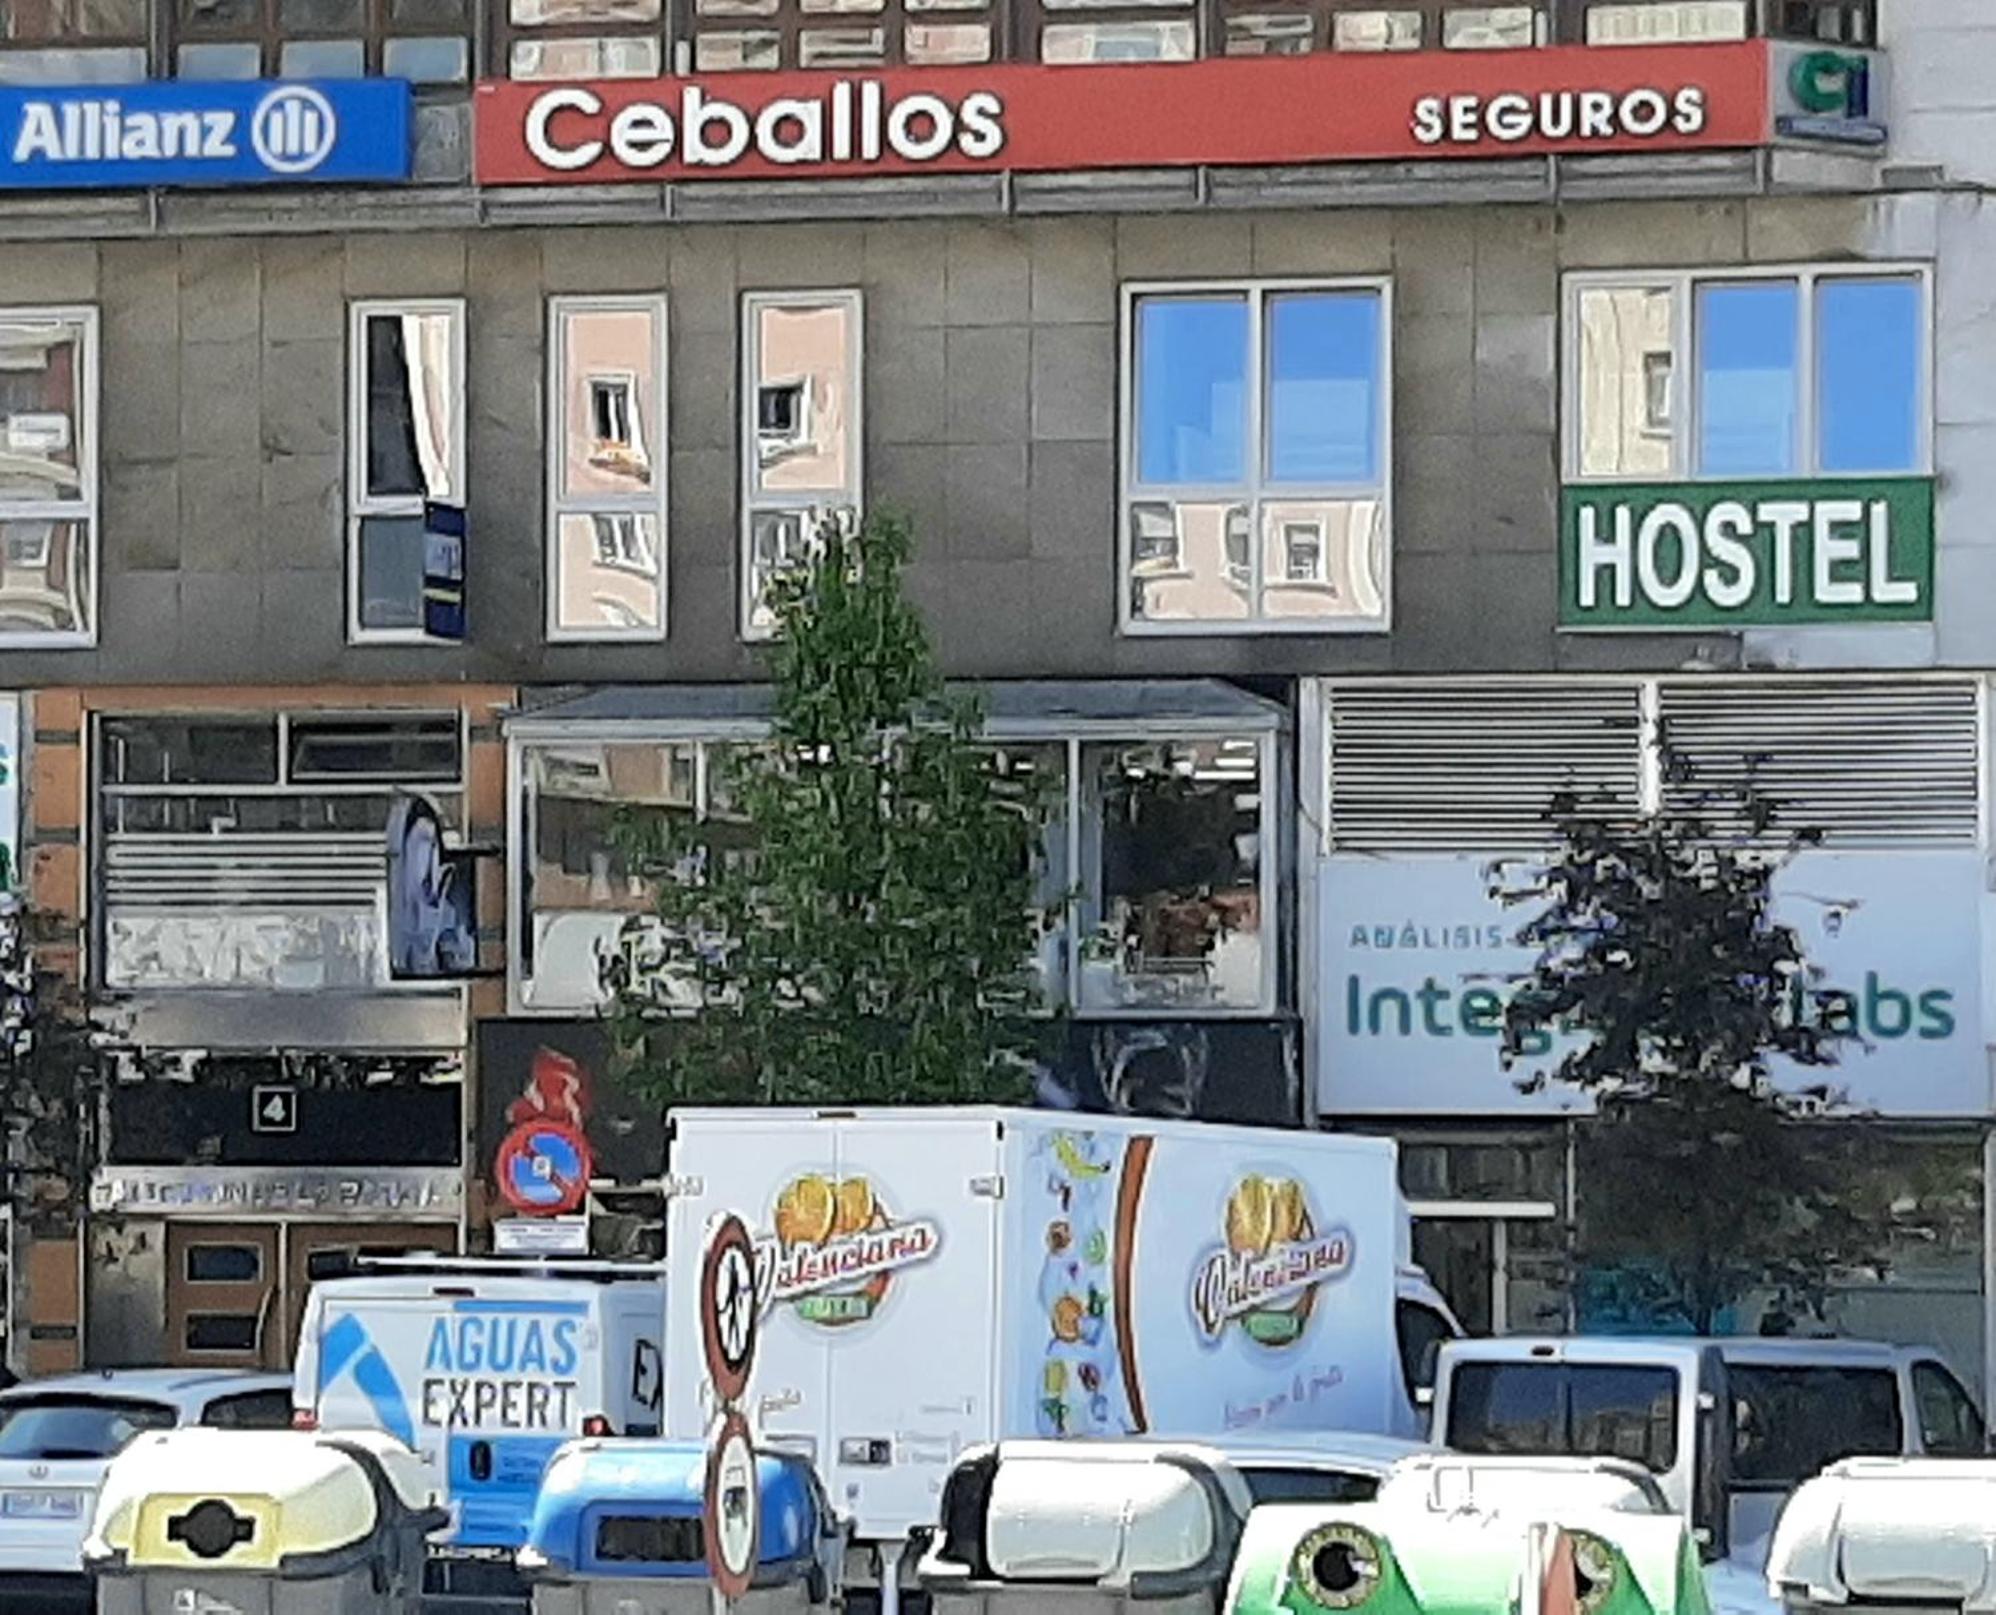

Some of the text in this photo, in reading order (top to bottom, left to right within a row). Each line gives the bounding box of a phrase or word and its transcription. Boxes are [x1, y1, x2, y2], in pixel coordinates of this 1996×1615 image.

[13, 101, 237, 163] Allianz
[524, 80, 1705, 170] Ceballos SEGUROS
[1578, 500, 1919, 608] HOSTEL
[262, 1094, 286, 1122] 4
[424, 1315, 577, 1376] AGUAS
[422, 1376, 577, 1429] EXPERT
